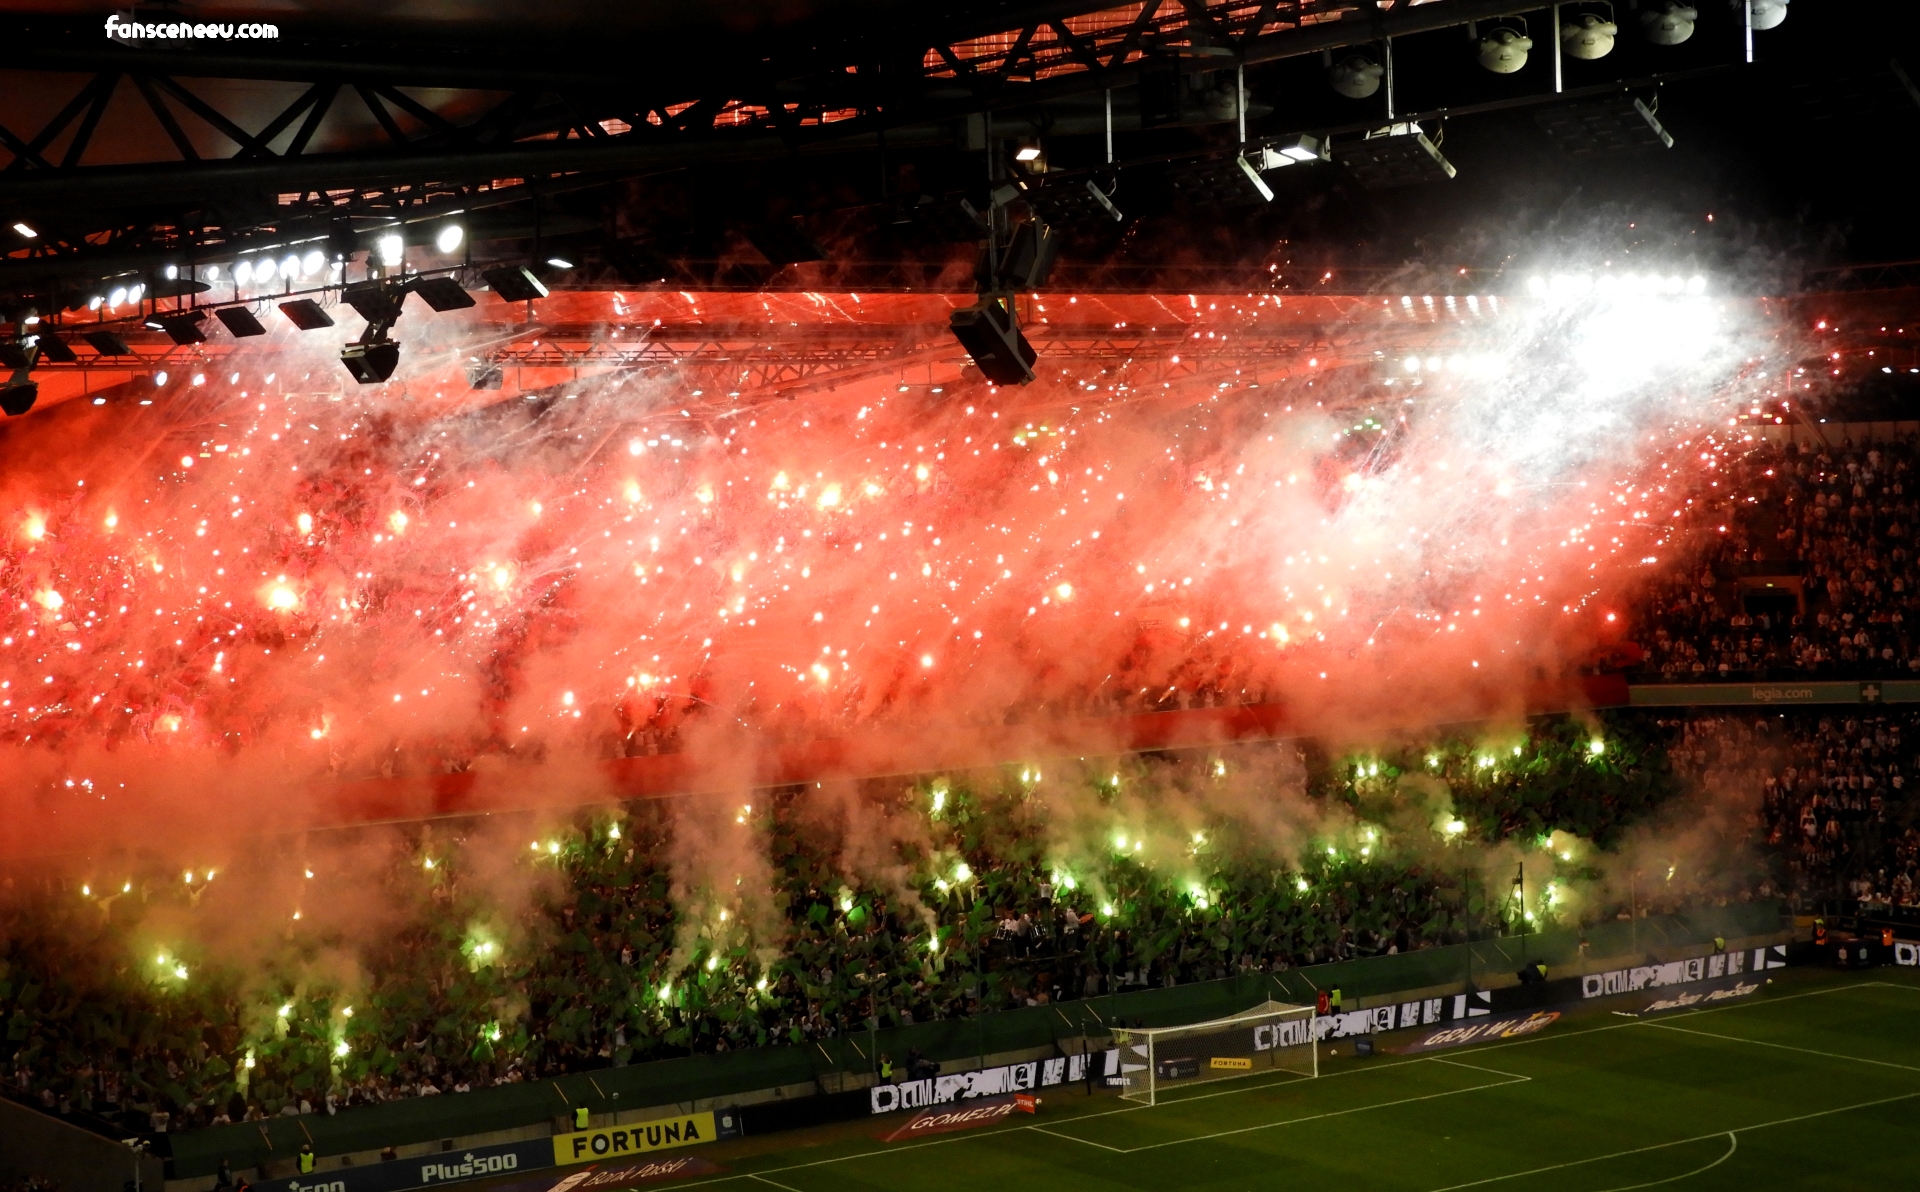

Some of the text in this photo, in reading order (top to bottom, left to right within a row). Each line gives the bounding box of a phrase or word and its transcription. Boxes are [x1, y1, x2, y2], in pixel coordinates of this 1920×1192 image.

[1752, 687, 1812, 701] legia.com
[910, 1101, 1019, 1130] GOMEZ.PL
[572, 1119, 701, 1159] FORTUNA
[421, 1152, 519, 1183] Plus500
[582, 1165, 637, 1187] Bank
